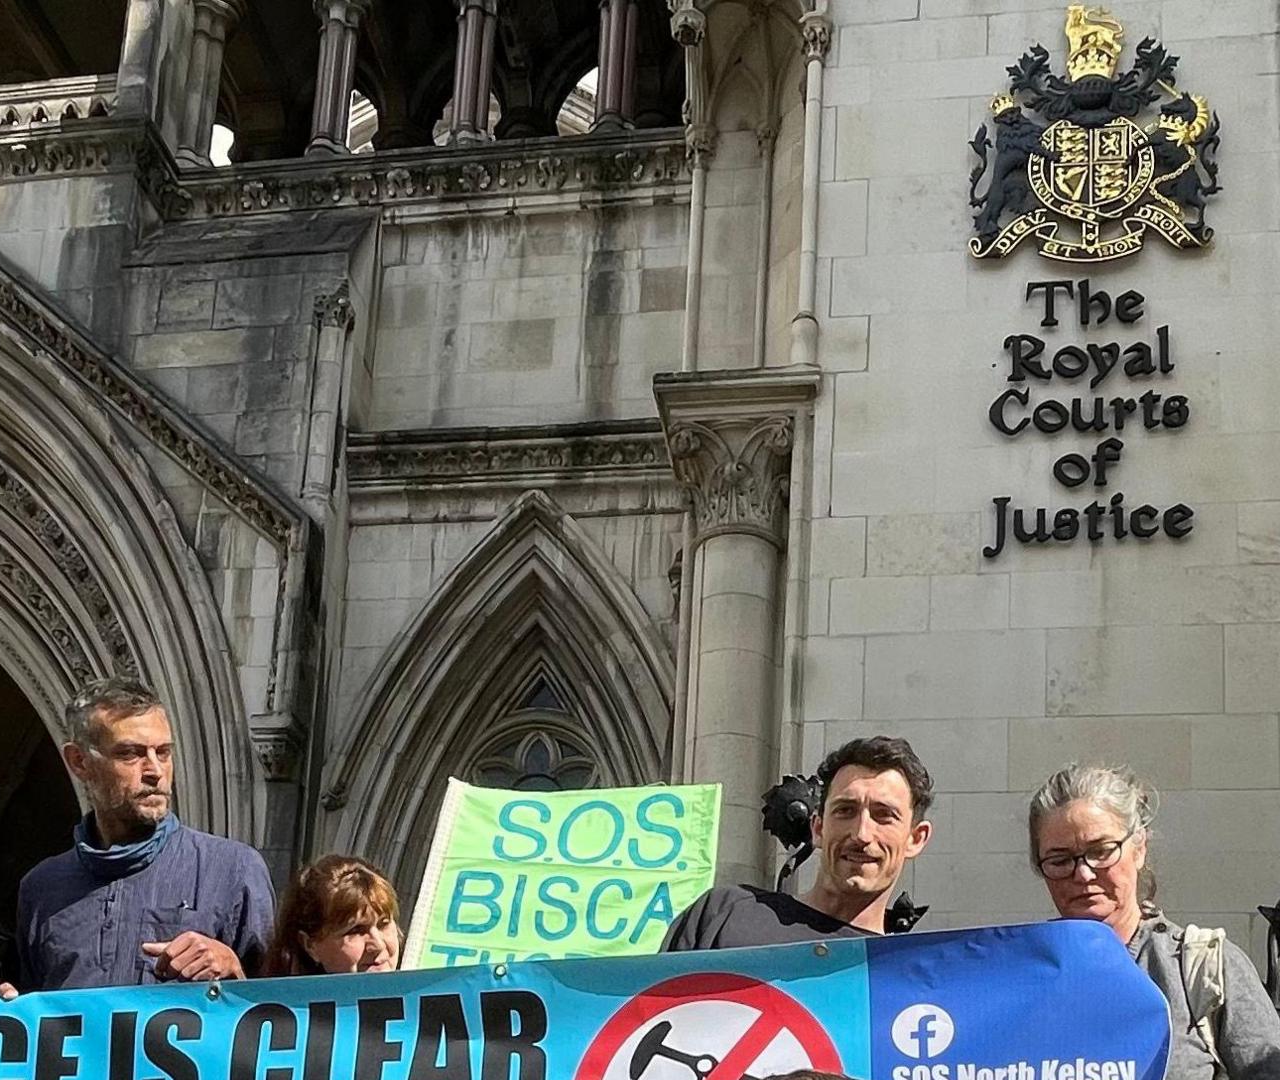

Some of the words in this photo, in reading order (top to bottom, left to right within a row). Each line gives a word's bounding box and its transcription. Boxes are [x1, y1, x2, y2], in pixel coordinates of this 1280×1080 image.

[1134, 206, 1190, 246] DROIT
[1026, 279, 1146, 327] The
[1004, 326, 1175, 390] Royal
[988, 387, 1190, 436] Courts
[1053, 437, 1124, 488] of
[983, 492, 1195, 559] Justice
[492, 793, 688, 871] S.O.S.
